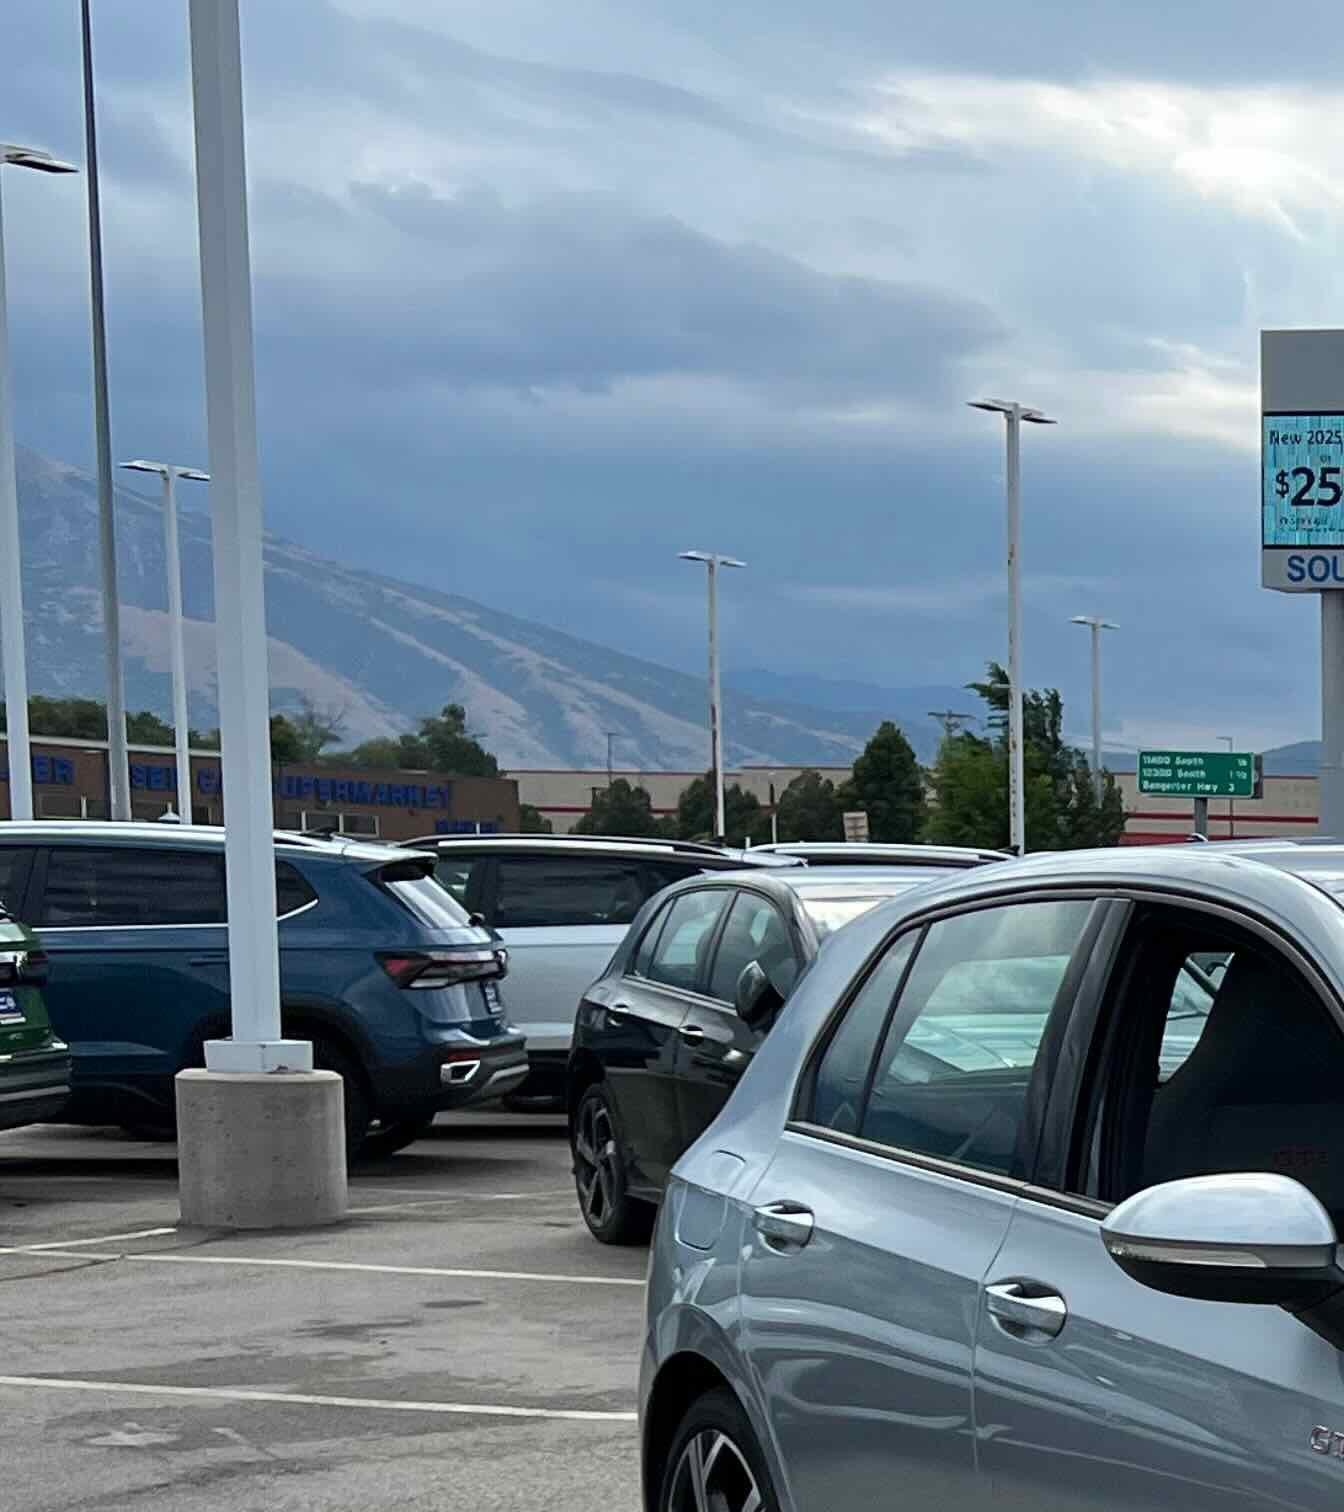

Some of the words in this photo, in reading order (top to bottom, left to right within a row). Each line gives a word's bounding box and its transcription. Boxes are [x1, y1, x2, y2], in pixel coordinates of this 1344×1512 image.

[1269, 430, 1302, 446] New
[1307, 430, 1342, 445] 2025
[1177, 770, 1206, 779] South
